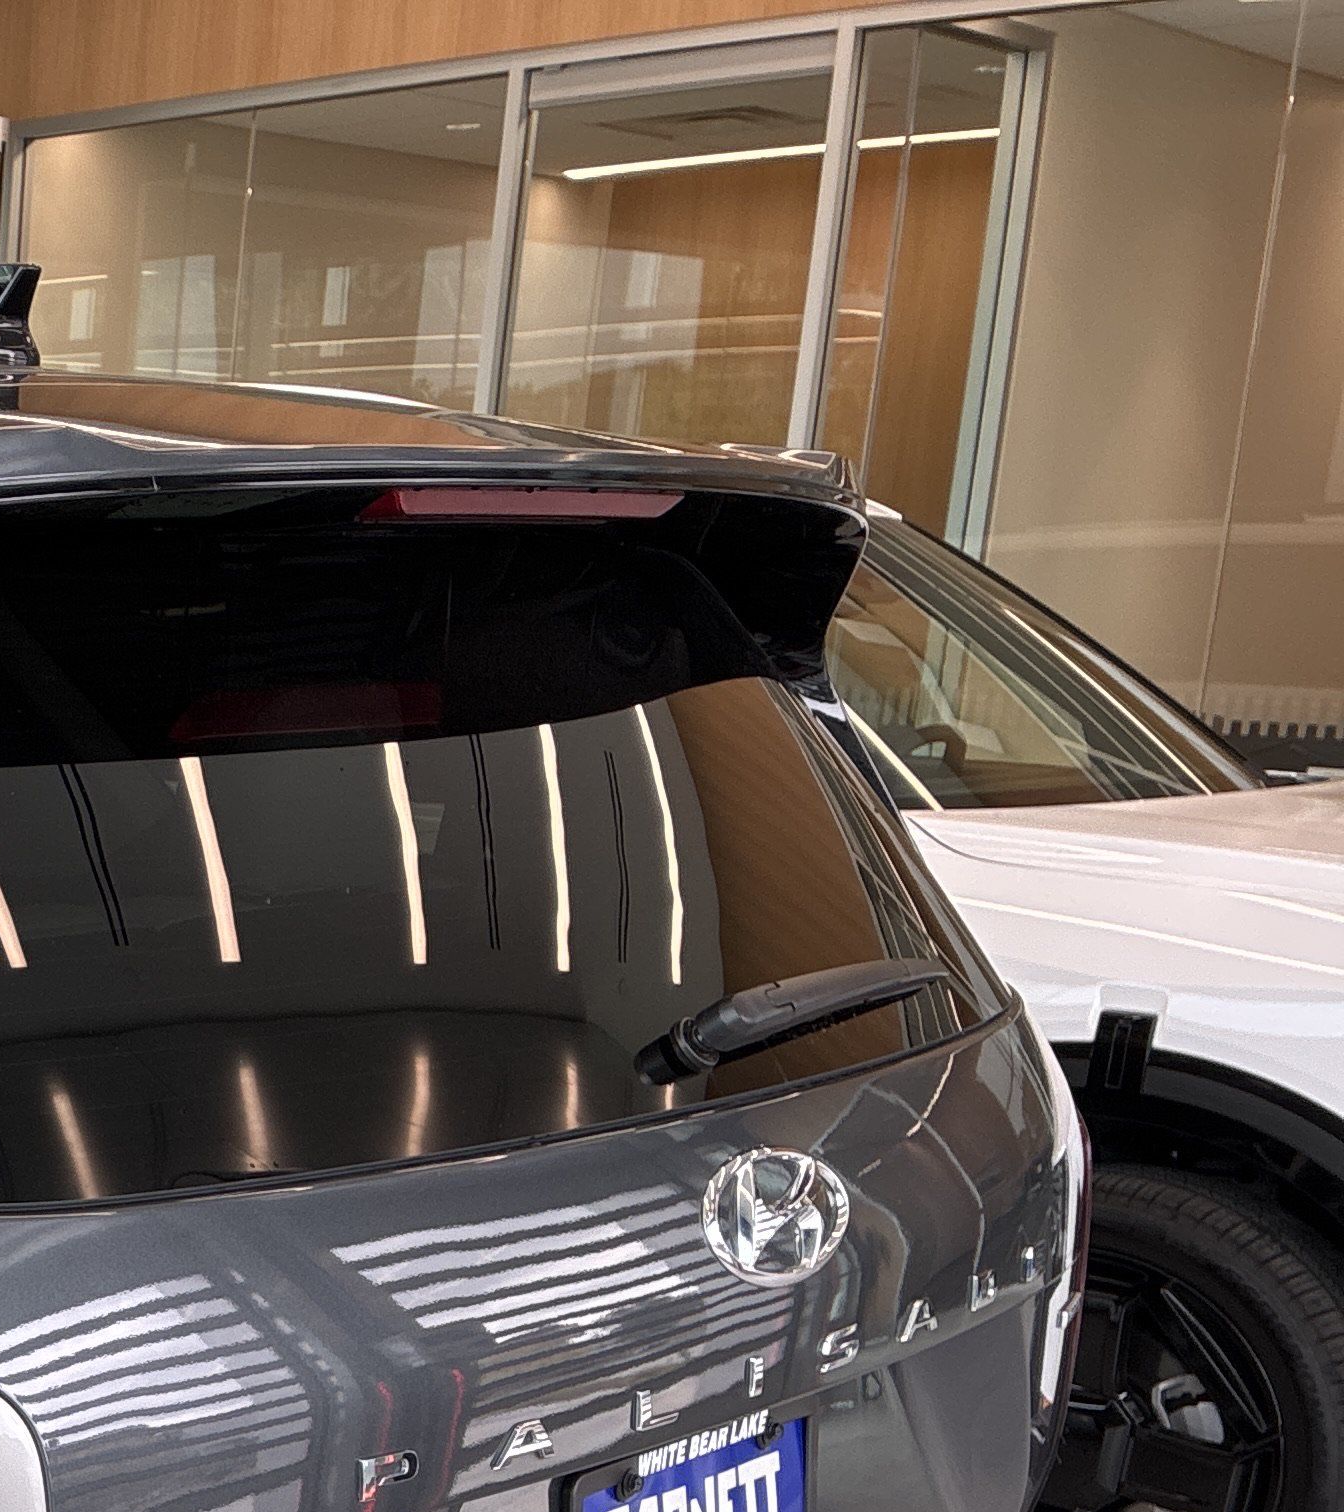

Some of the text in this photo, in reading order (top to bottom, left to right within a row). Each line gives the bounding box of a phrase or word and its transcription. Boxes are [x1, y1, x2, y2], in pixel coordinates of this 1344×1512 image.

[638, 1408, 769, 1477] WHITE BEAR LAKE
